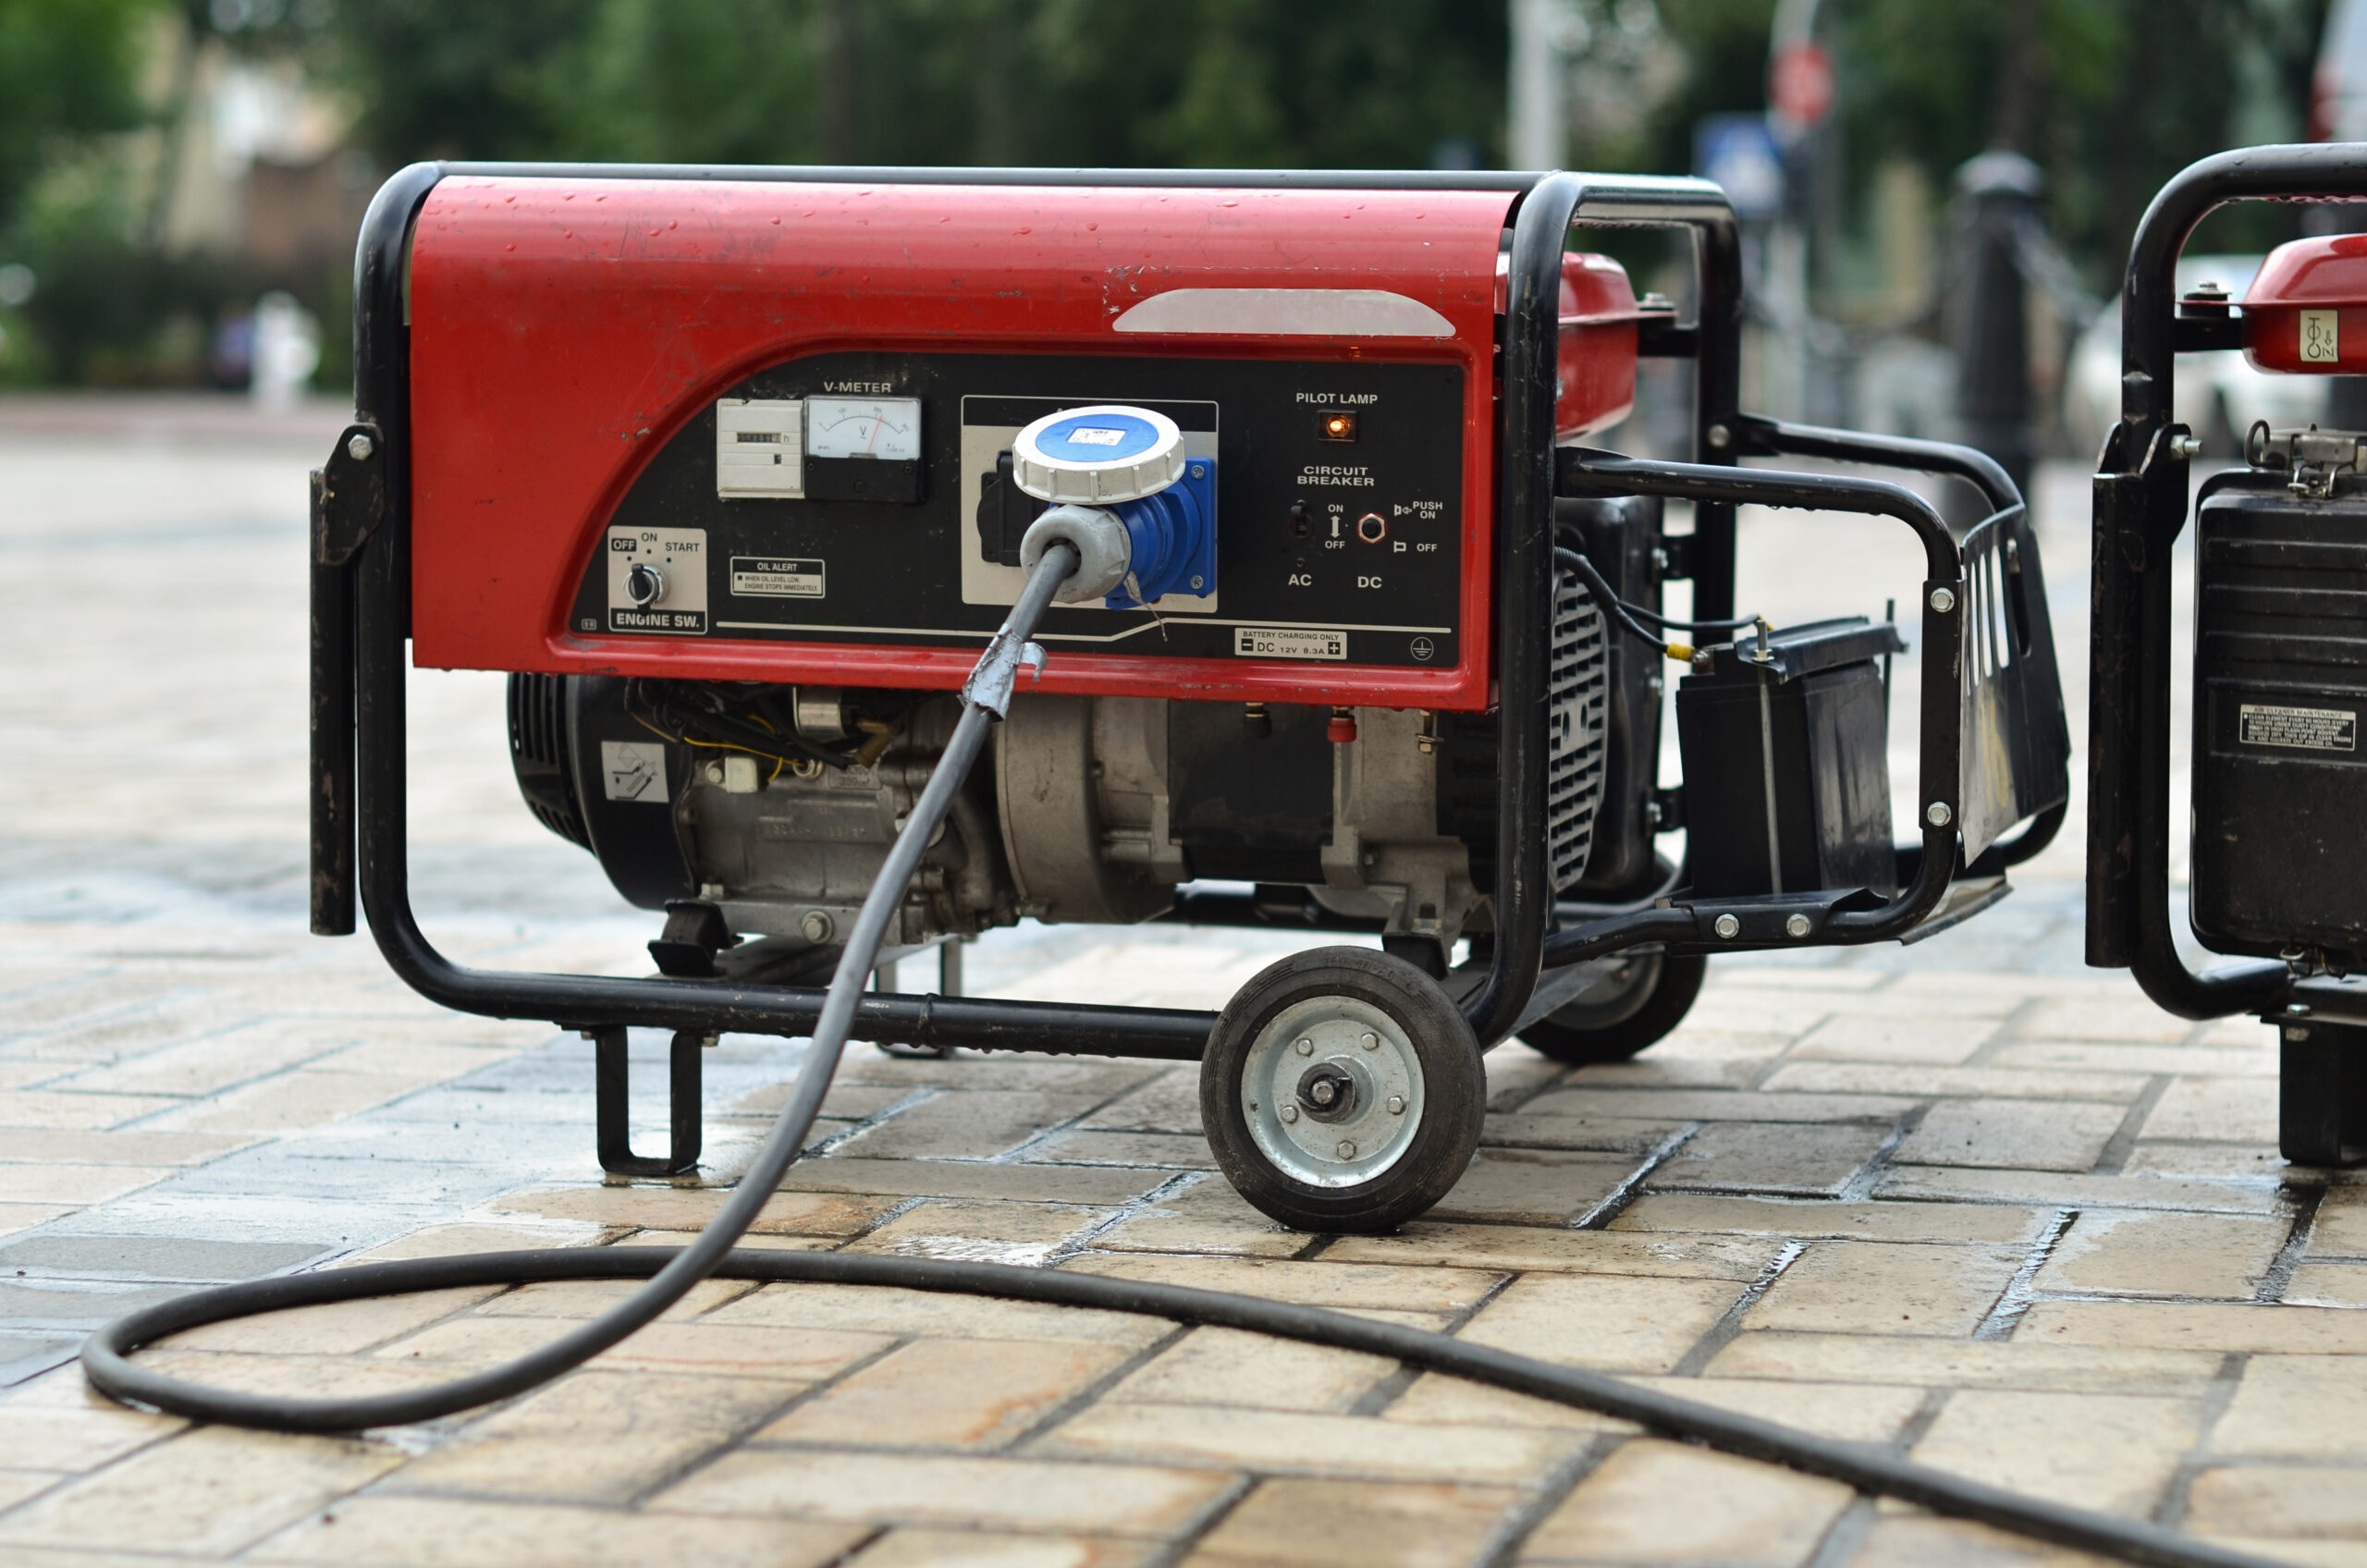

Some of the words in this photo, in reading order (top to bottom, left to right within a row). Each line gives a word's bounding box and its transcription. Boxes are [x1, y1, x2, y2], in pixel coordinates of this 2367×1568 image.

[824, 382, 891, 393] V-METER
[1295, 393, 1336, 403] PILOT
[1340, 394, 1379, 404] LAMP
[1304, 466, 1368, 476] CIRCUIT
[1297, 476, 1375, 486] BREAKER
[1328, 504, 1343, 513] ON
[1413, 501, 1443, 510] PUSH
[1419, 510, 1436, 520] ON
[641, 533, 657, 542] ON
[613, 540, 635, 550] OFF
[666, 543, 700, 552] START
[1325, 541, 1345, 549] OFF
[1417, 544, 1438, 552] OFF
[757, 562, 770, 570] OIL
[772, 563, 798, 571] ALERT
[1288, 574, 1312, 586] AC
[1357, 576, 1382, 589] DC
[617, 613, 669, 626] ENGINE
[674, 616, 700, 628] SW.
[1243, 631, 1276, 639] BATTERY
[1257, 643, 1275, 653] DC
[2297, 709, 2342, 718] MAINTENANCE
